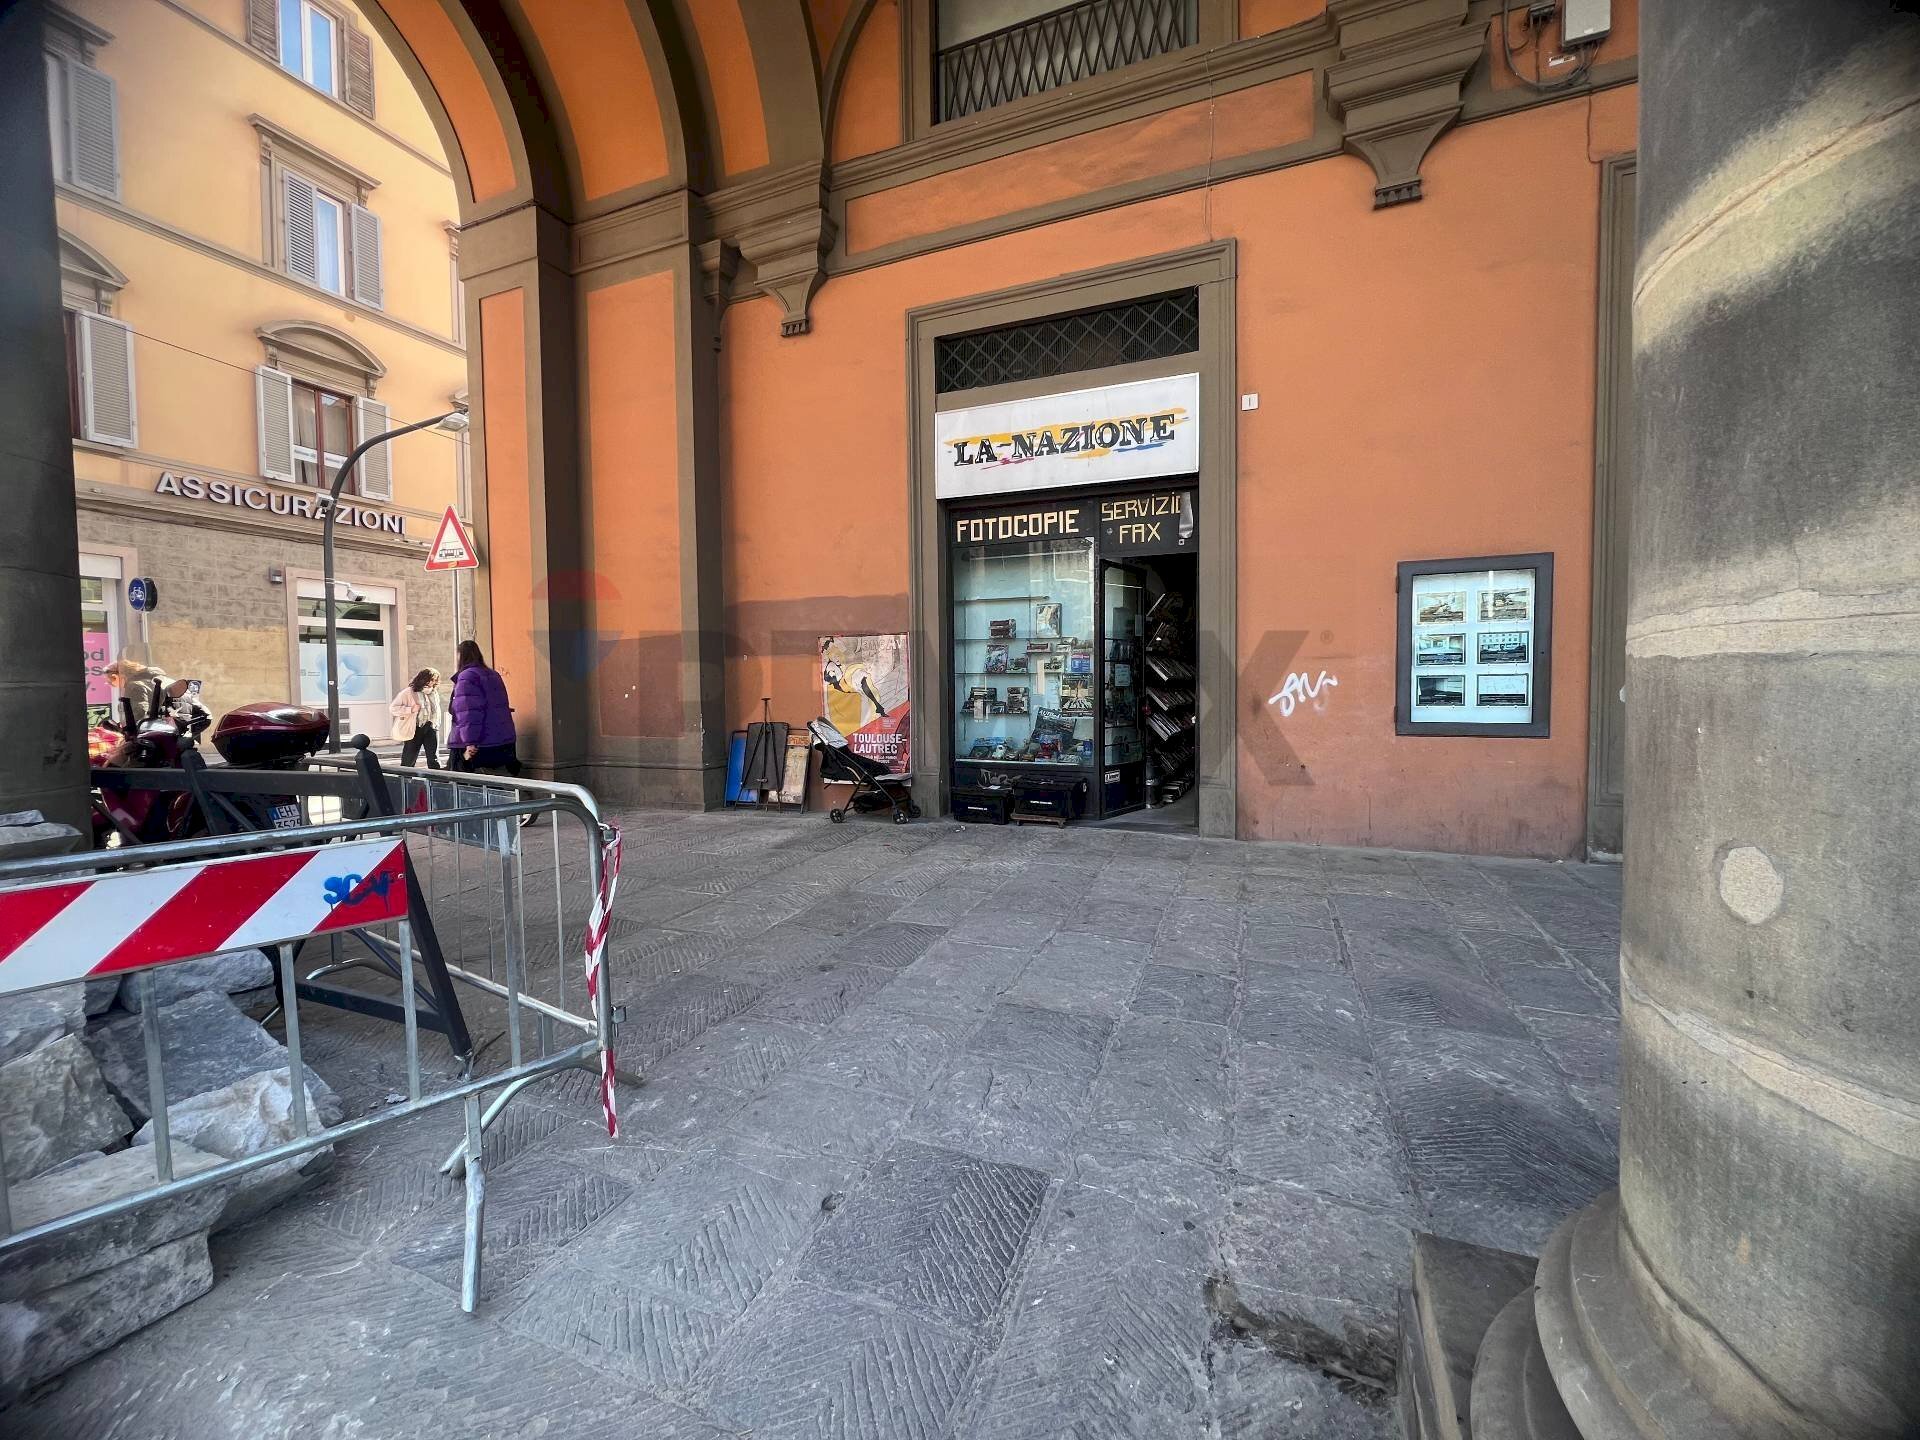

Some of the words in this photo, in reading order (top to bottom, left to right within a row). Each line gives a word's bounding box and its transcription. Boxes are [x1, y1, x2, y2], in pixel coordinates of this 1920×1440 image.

[953, 438, 998, 467] LA
[1010, 413, 1176, 459] NAZIONE
[956, 508, 1080, 543] FOTOCOPIE
[1118, 521, 1162, 544] FAX
[852, 733, 908, 744] TOULOUSE-
[853, 743, 898, 754] LAUTREC
